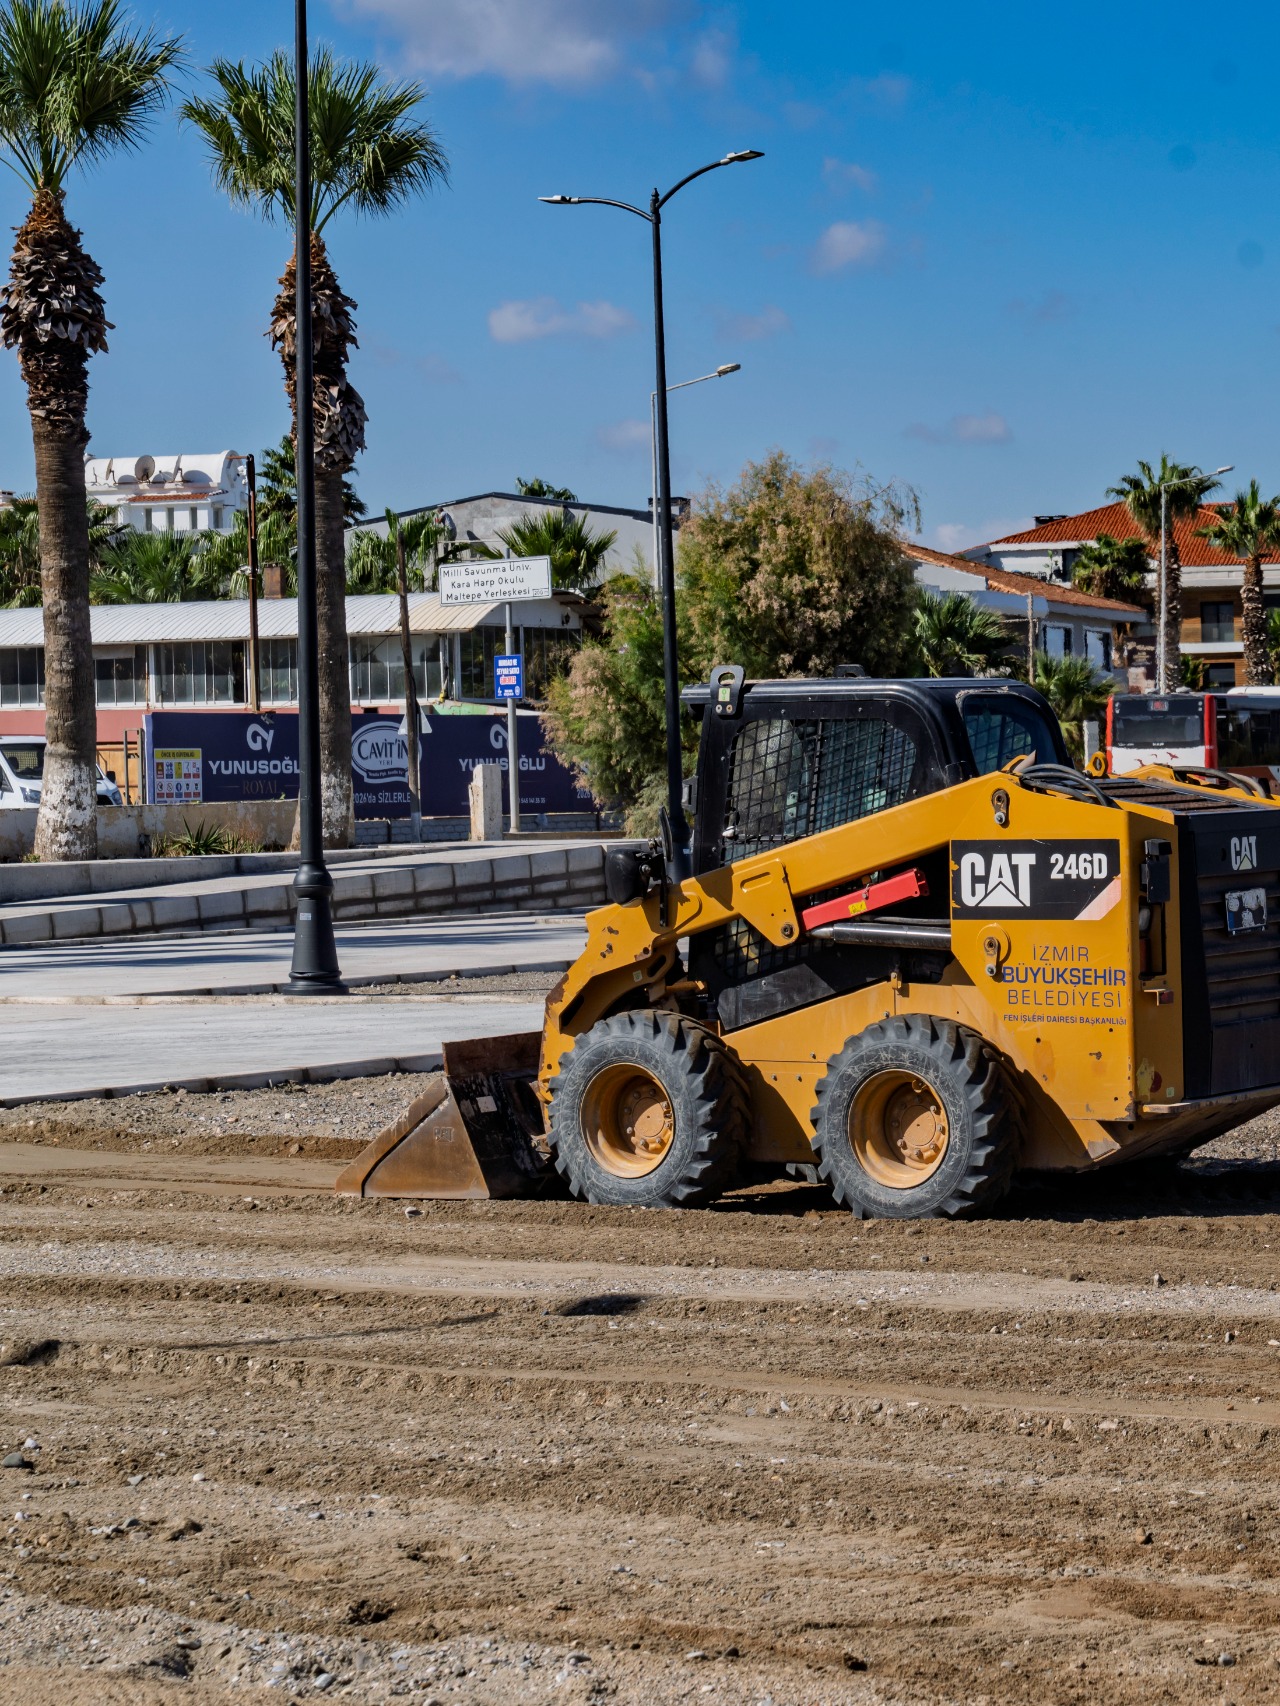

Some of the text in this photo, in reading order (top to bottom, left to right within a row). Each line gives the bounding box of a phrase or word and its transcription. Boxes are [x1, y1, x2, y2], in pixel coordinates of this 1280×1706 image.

[443, 561, 532, 578] Milli Savunma Üniv.
[451, 575, 525, 589] Kara Harp Okulu
[446, 591, 482, 602] Maltepe
[484, 586, 531, 598] Yerleşkesi
[208, 755, 300, 775] YUNUSOĞL
[458, 754, 546, 772] YUSĞLU
[242, 779, 281, 795] ROYAL
[378, 790, 411, 803] SİZLERLE
[1230, 835, 1258, 871] CAT
[960, 852, 1108, 907] CAT 246D
[1033, 944, 1089, 963] İZMİR
[1002, 962, 1127, 988] BÜYÜKŞEHİR
[1007, 988, 1121, 1008] BELEDİYESİ
[1003, 1014, 1019, 1022] FEN
[1020, 1012, 1045, 1024] İŞLERİ
[1046, 1014, 1078, 1024] DAİRESİ
